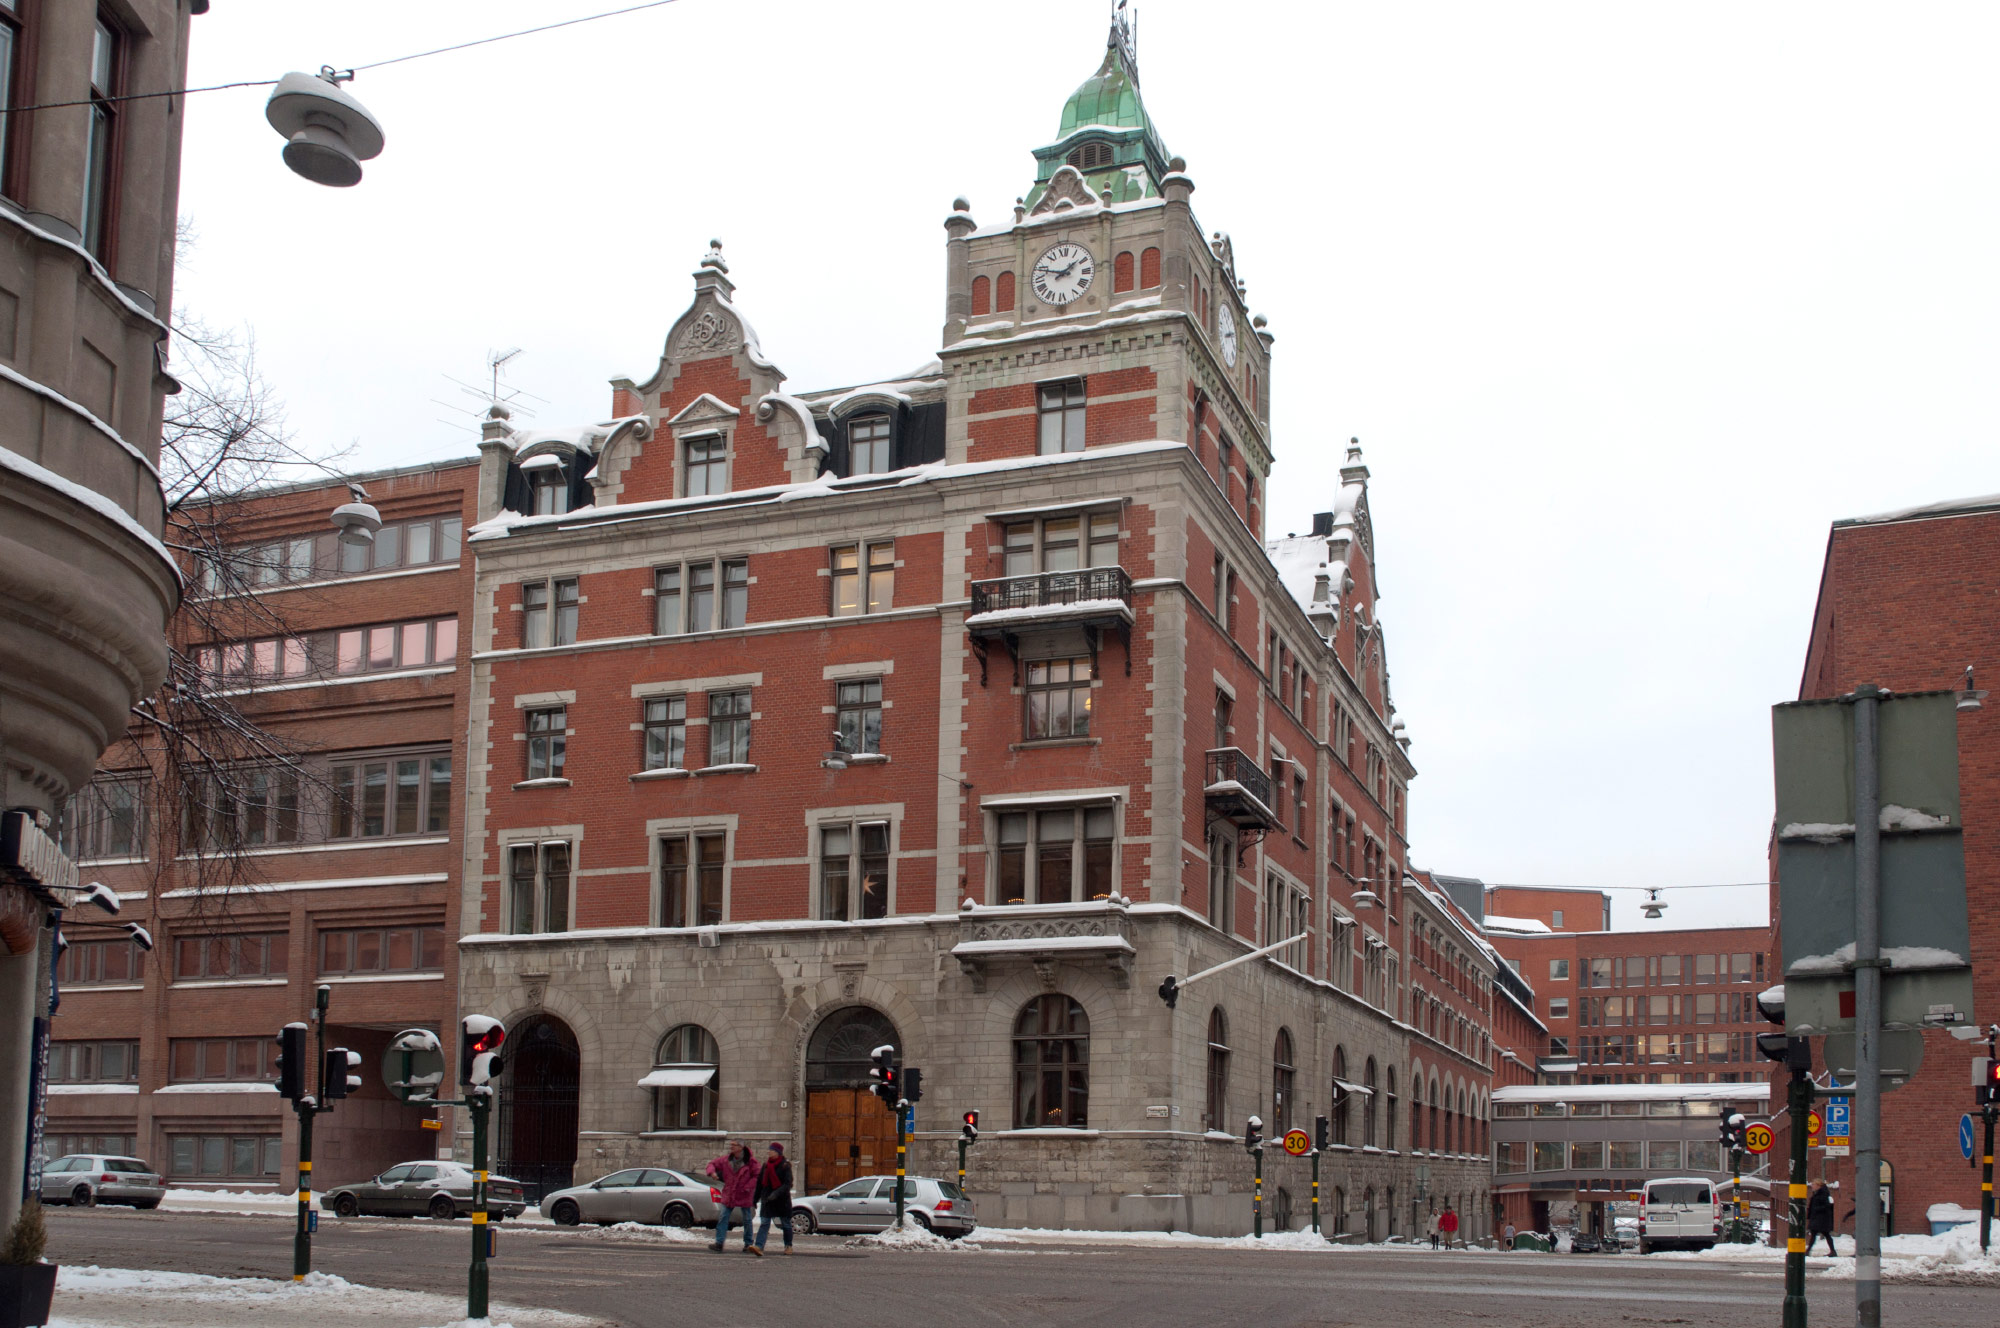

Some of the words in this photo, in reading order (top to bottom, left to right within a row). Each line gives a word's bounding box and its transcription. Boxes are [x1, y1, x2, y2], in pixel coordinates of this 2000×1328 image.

[1833, 1108, 1845, 1121] P
[1288, 1137, 1306, 1149] 30
[1748, 1132, 1770, 1146] 30
